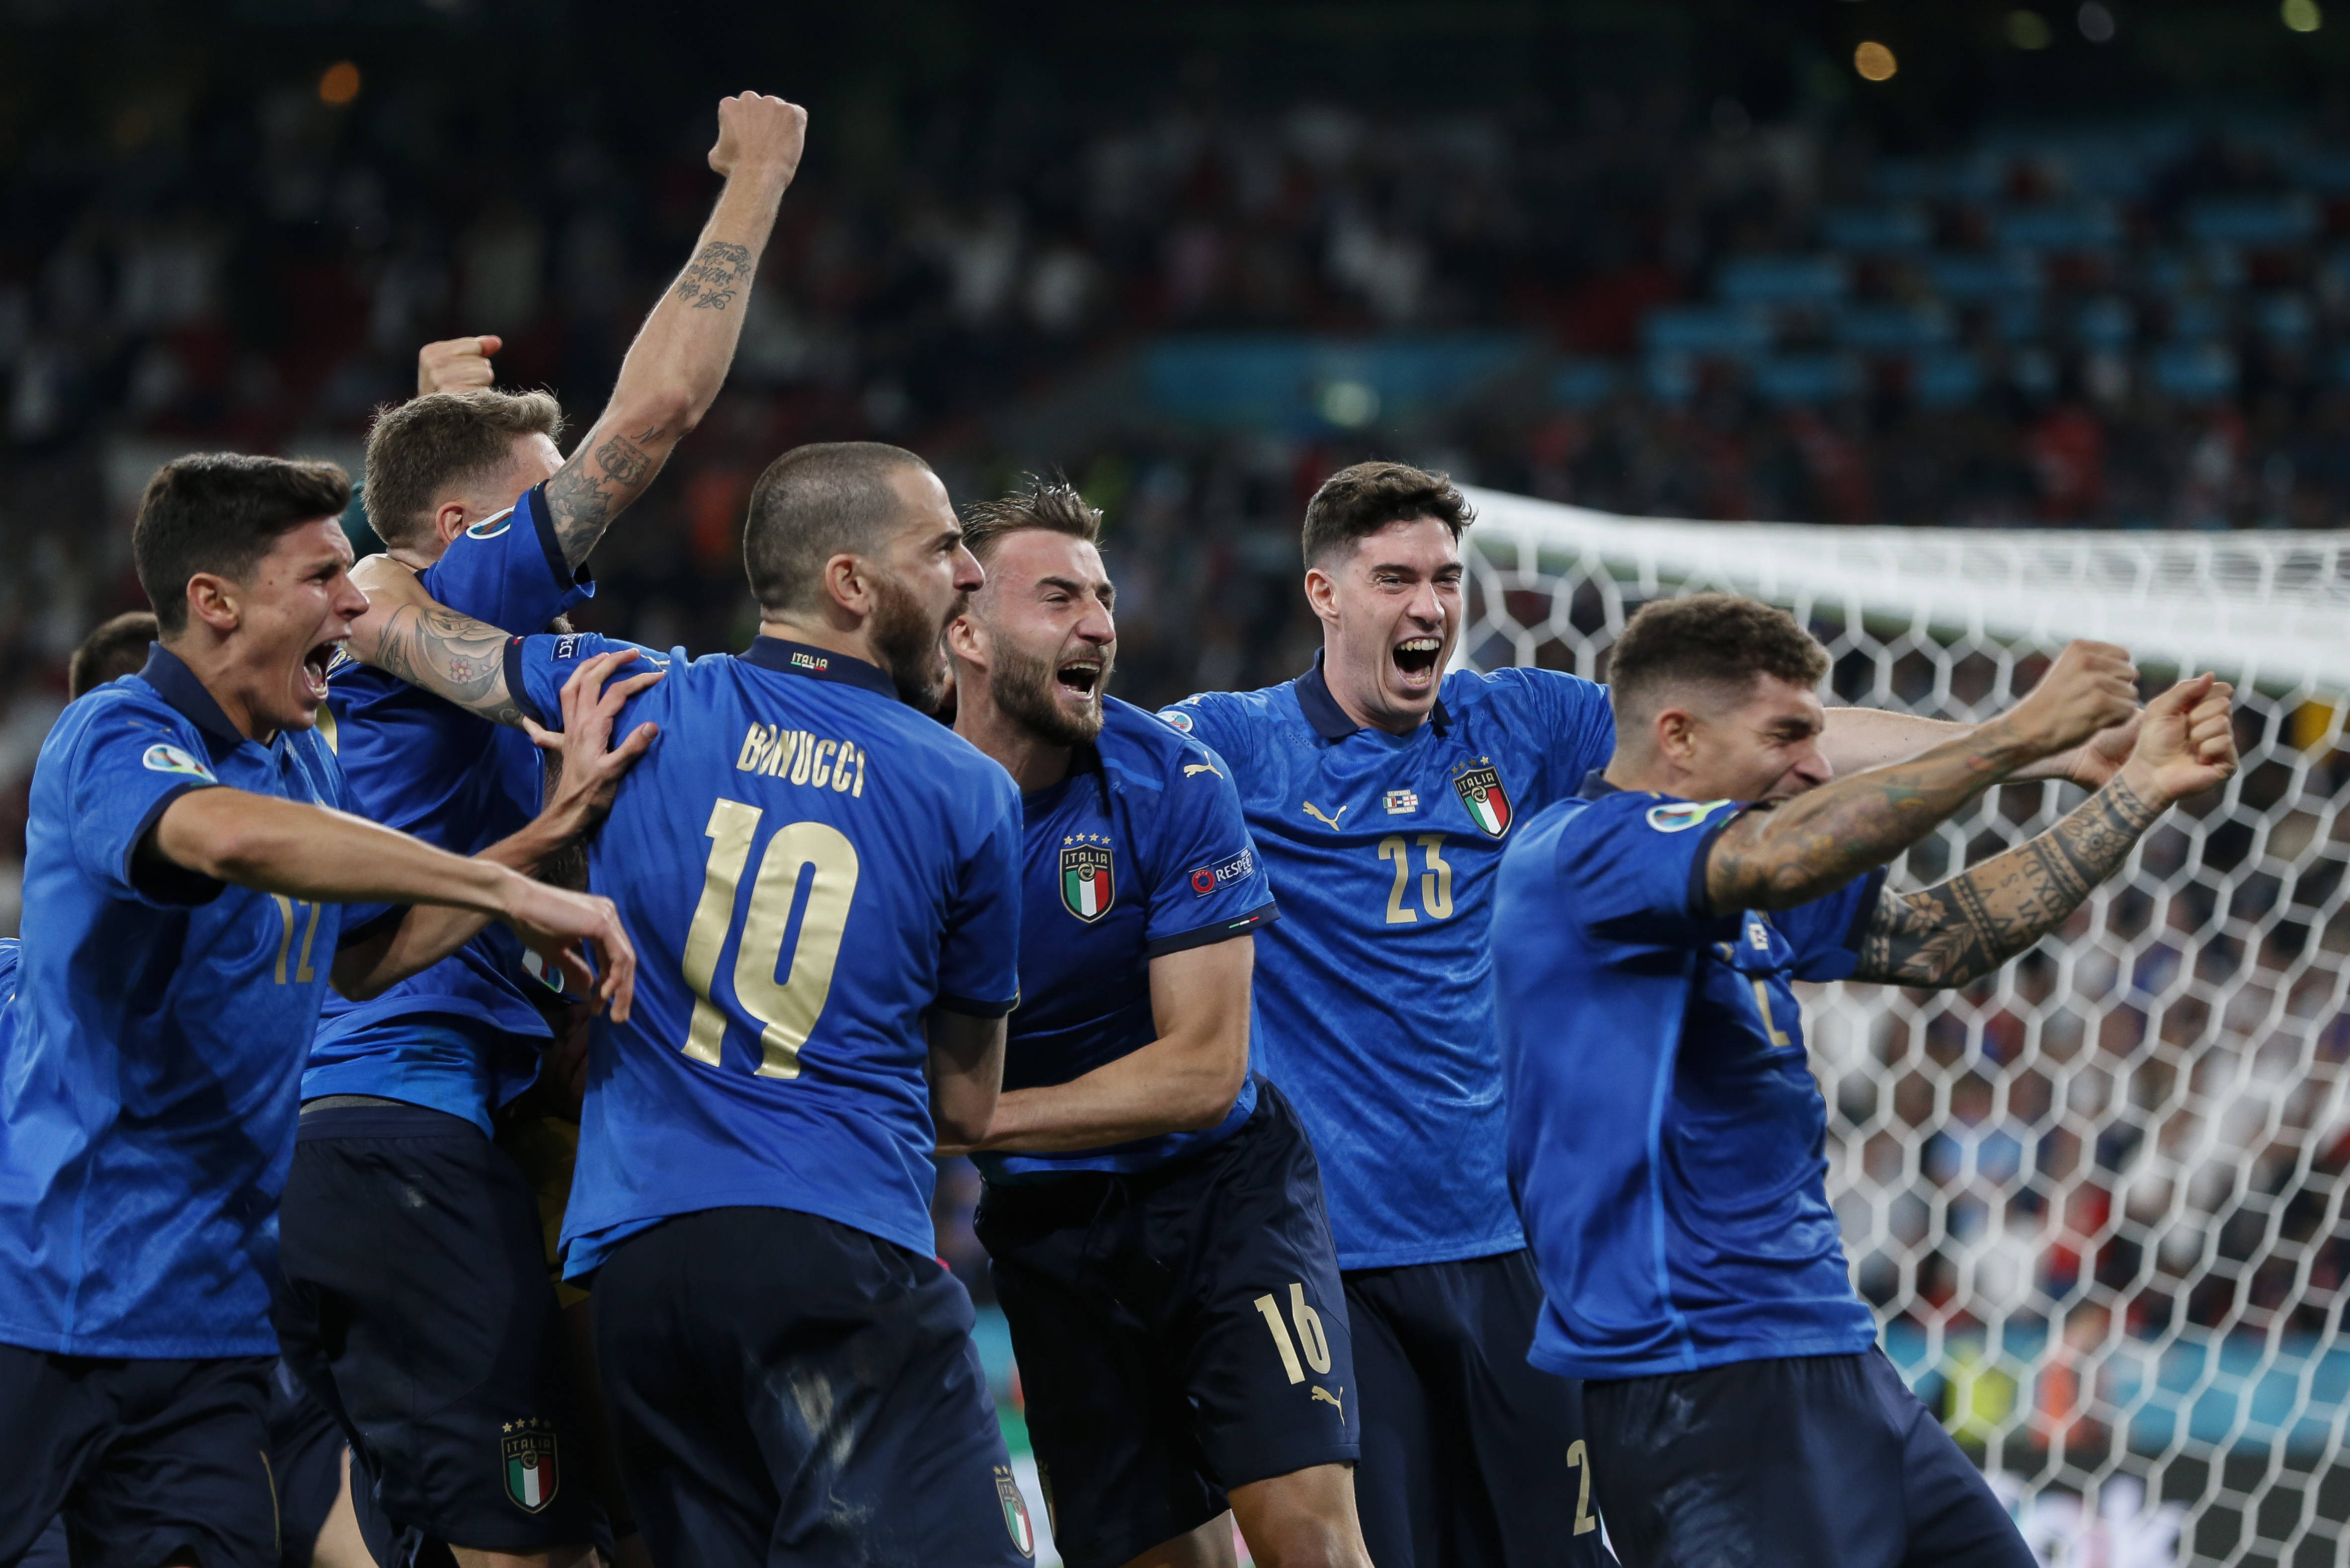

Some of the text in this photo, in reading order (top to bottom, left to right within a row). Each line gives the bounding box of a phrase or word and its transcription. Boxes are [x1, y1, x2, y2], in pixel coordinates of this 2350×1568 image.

[792, 652, 828, 668] ITALIA
[736, 721, 866, 798] BONUCCI
[1458, 773, 1495, 791] ITALIA
[1065, 852, 1108, 864] ITALIA
[1378, 835, 1454, 924] 23
[681, 797, 860, 1080] 19
[1253, 1282, 1332, 1385] 16
[507, 1438, 551, 1453] ITALIA
[1566, 1439, 1596, 1536] 2
